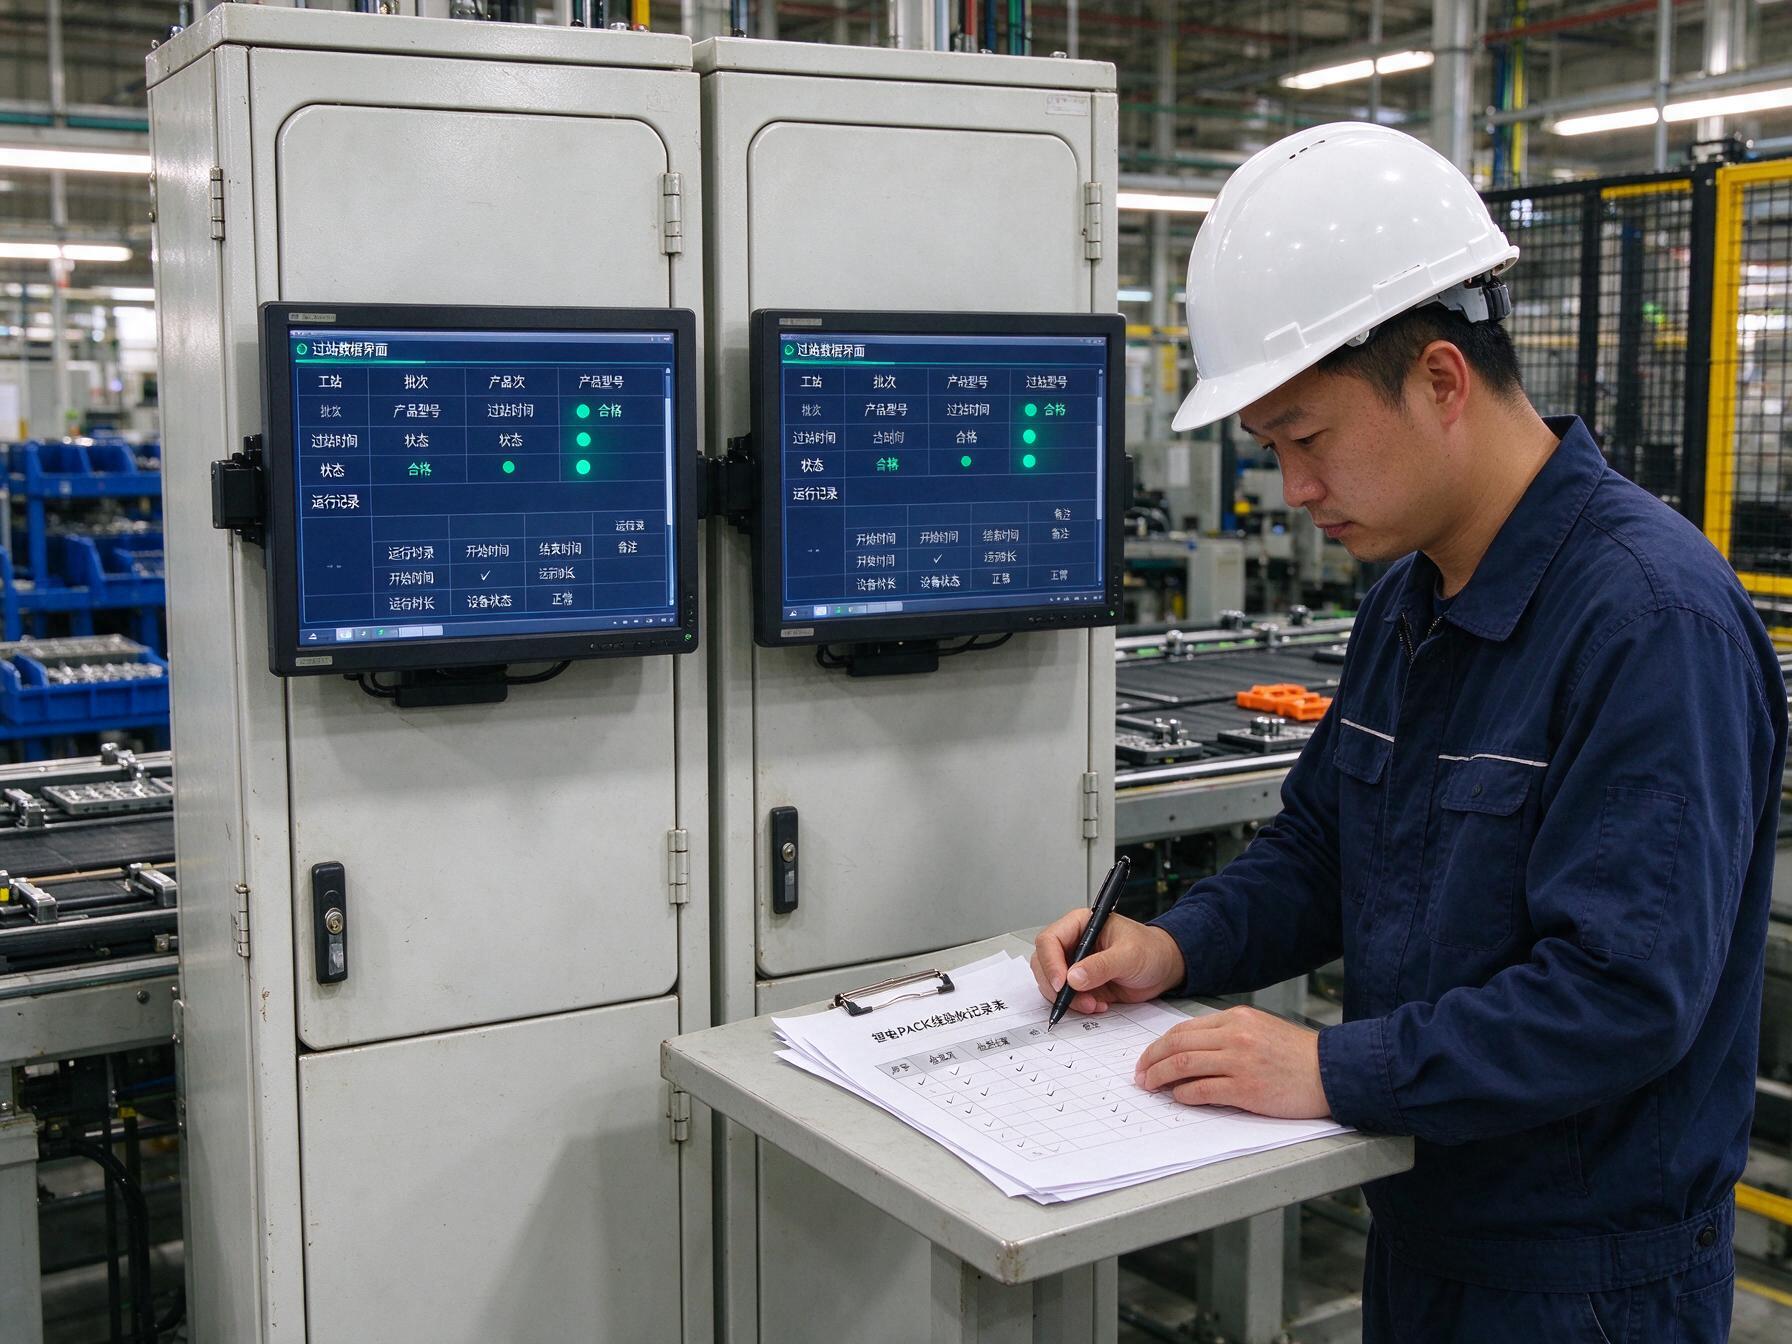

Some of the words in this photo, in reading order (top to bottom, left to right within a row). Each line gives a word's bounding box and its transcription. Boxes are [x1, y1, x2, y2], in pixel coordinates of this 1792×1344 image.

[318, 374, 342, 388] 工站
[404, 374, 428, 389] 批次
[394, 404, 441, 418] 产品型号
[487, 402, 533, 417] 过站时间
[598, 403, 622, 418] 合格
[405, 432, 428, 448] 状态
[499, 432, 523, 447] 状态
[320, 462, 344, 477] 状态
[801, 458, 824, 472] 状态
[312, 494, 359, 509] 运行记录
[793, 487, 838, 501] 运行记录
